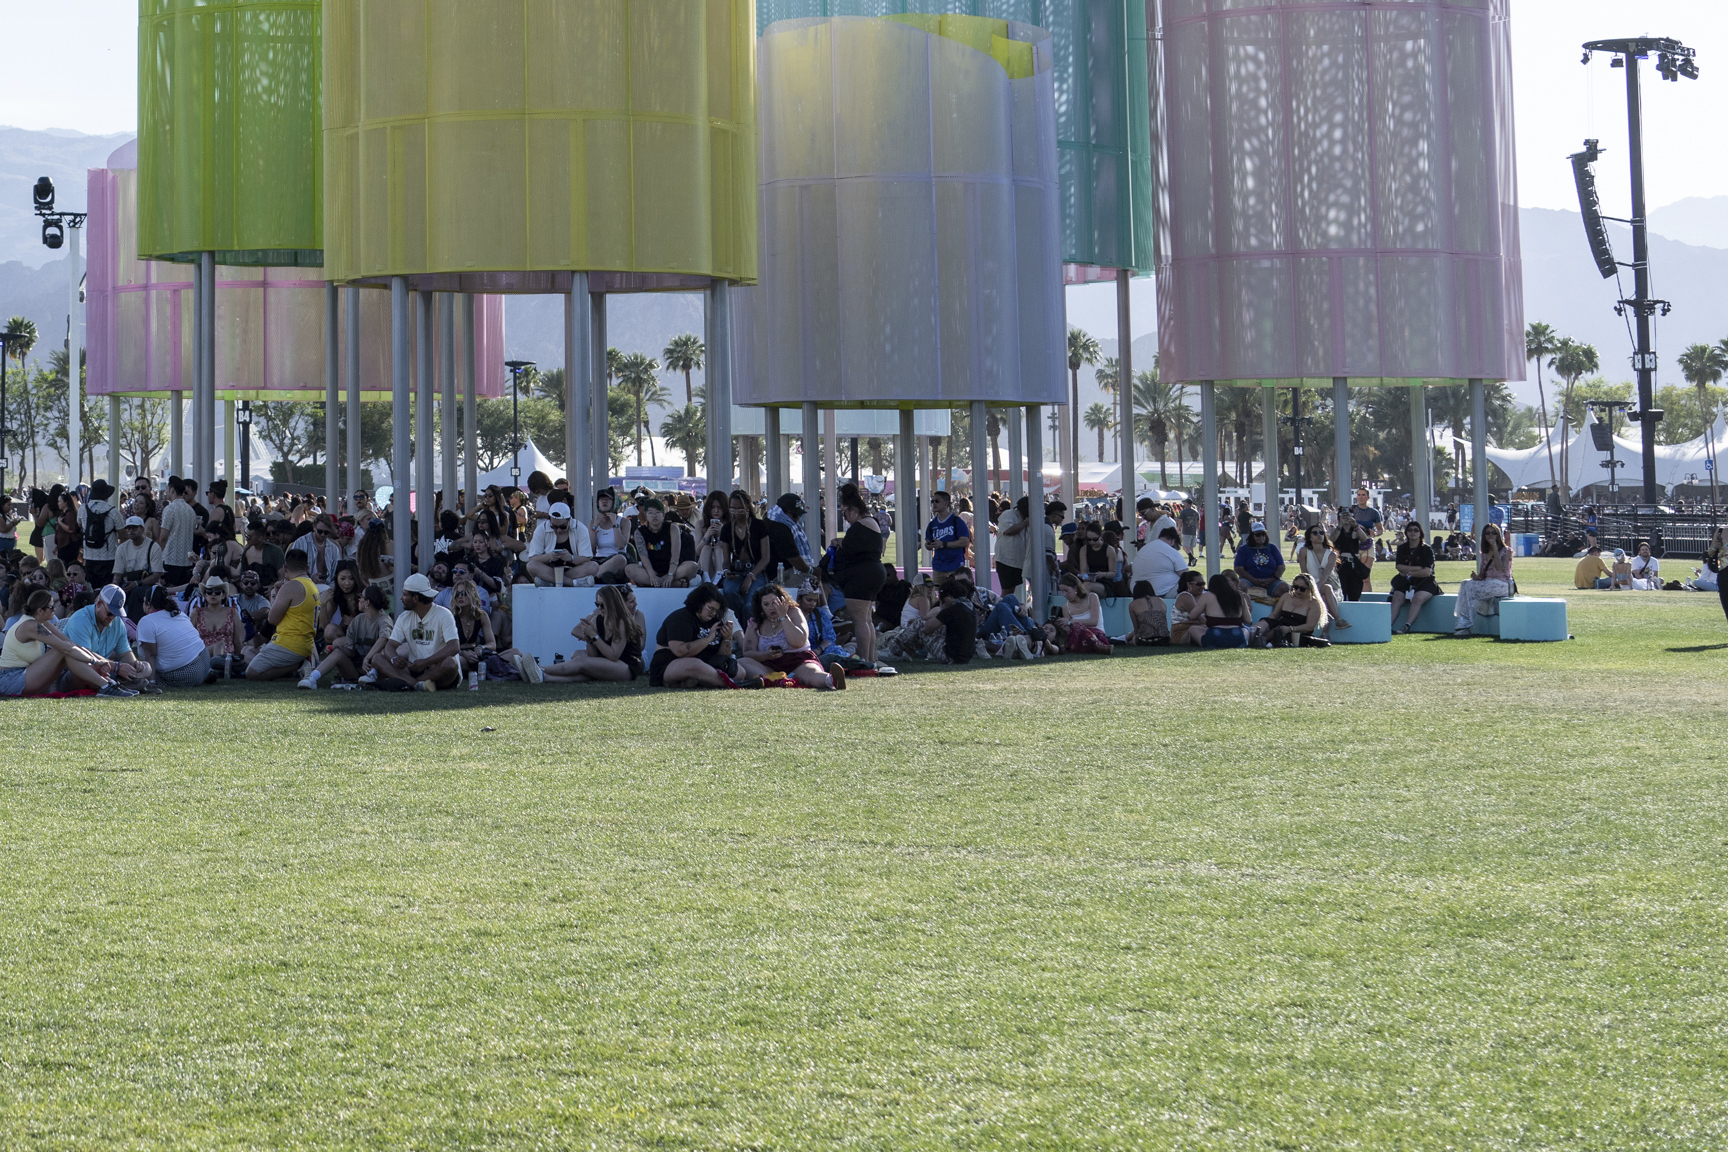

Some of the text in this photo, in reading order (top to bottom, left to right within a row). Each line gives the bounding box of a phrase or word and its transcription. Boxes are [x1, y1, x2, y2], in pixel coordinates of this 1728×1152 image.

[1634, 353, 1642, 369] B3
[1644, 353, 1656, 369] B3
[238, 410, 250, 422] B4
[1294, 446, 1303, 455] D4
[511, 468, 520, 476] D5
[932, 525, 955, 540] Lions
